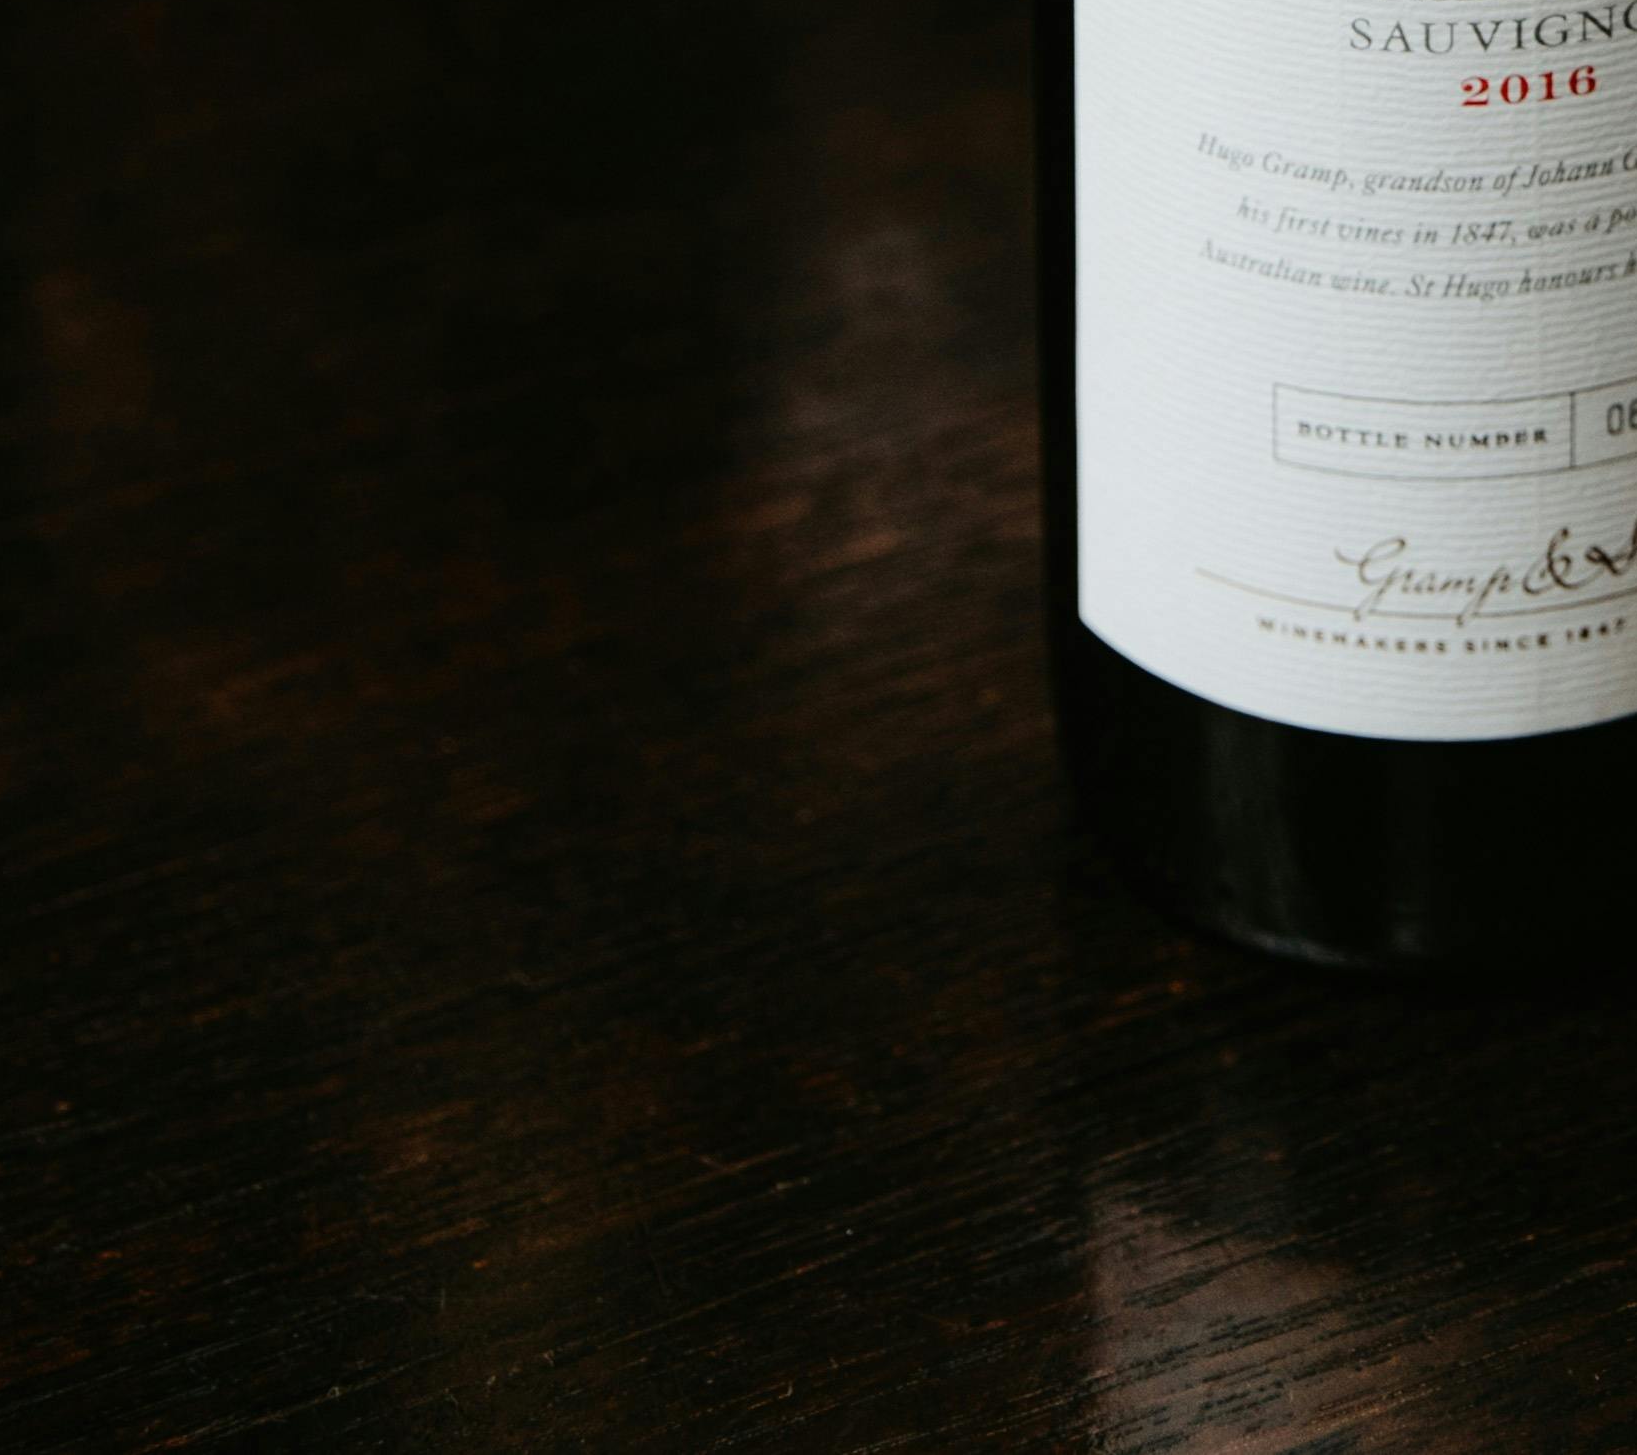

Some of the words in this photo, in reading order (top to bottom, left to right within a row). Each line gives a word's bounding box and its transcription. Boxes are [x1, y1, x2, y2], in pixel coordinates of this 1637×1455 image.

[1460, 65, 1599, 108] 2016
[1197, 132, 1254, 170] Hugo
[1262, 151, 1355, 191] Gramp,
[1363, 170, 1484, 196] grandson
[1492, 172, 1518, 197] of
[1522, 157, 1614, 188] Johann
[1236, 196, 1268, 224] his
[1274, 206, 1331, 234] first
[1337, 218, 1404, 245] vines
[1414, 224, 1439, 245] in
[1451, 219, 1516, 245] 1847,
[1527, 217, 1575, 240] was
[1585, 214, 1600, 234] a
[1198, 240, 1324, 288] Australian
[1331, 269, 1396, 297] wine.
[1405, 273, 1436, 298] St
[1442, 273, 1511, 302] Hugo
[1517, 266, 1618, 294] honours
[1297, 420, 1409, 449] BOTTLE
[1424, 426, 1549, 449] NUMBER
[1334, 537, 1511, 628] Gramp
[1522, 527, 1595, 595] &
